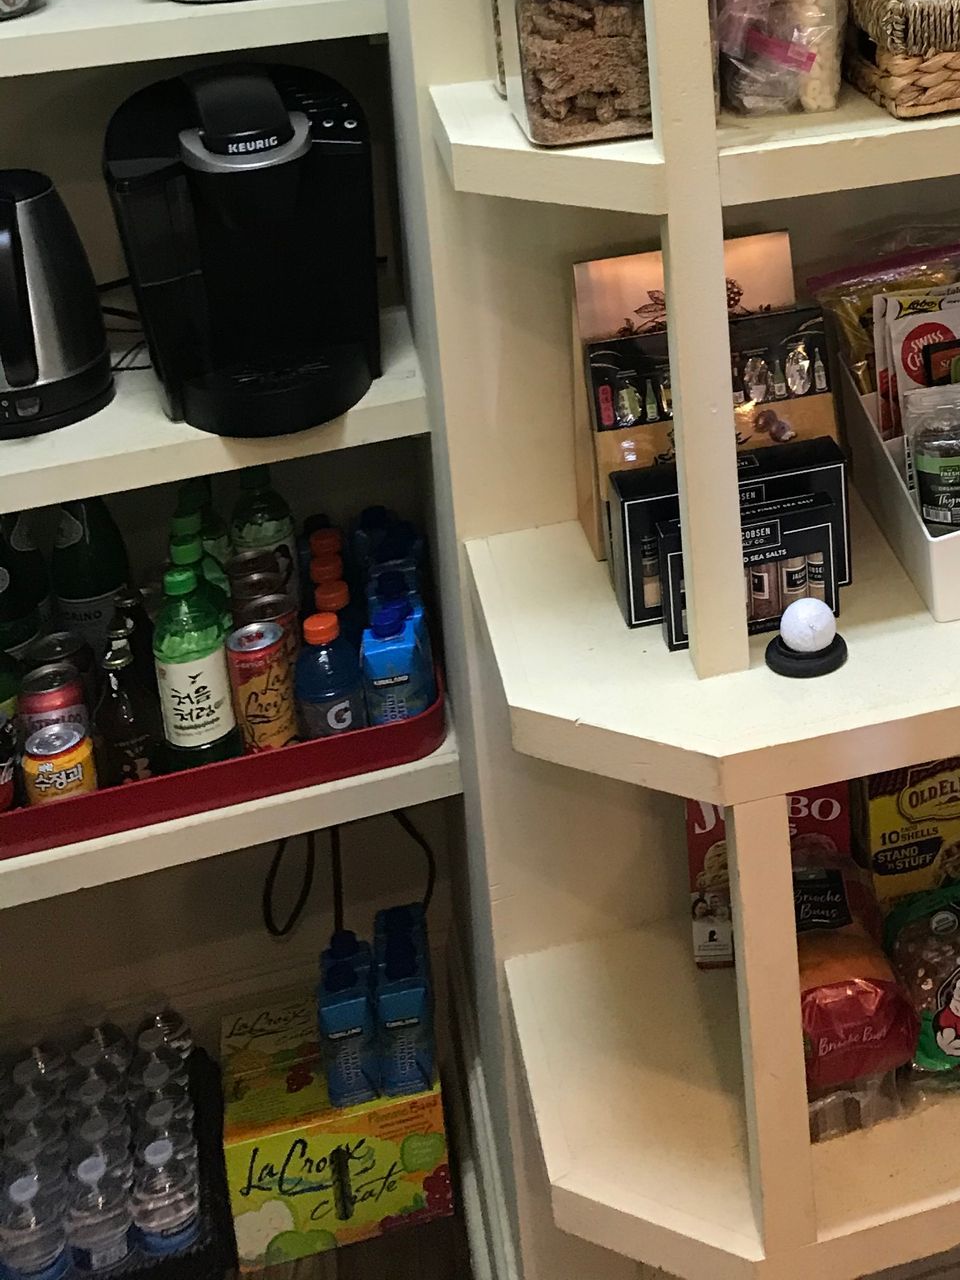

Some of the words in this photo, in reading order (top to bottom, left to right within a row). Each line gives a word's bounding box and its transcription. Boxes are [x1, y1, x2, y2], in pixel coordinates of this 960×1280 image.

[228, 136, 278, 154] KEURIG
[911, 329, 944, 352] SWISS
[741, 527, 771, 540] COBSEN
[750, 552, 765, 563] SEA
[766, 548, 788, 560] SALTS
[170, 684, 212, 706] 처음
[326, 699, 353, 730] G
[34, 765, 83, 791] 수정과
[908, 788, 938, 809] OLD
[939, 779, 956, 797] EL
[879, 830, 900, 846] 10
[900, 826, 939, 842] SHELLS
[877, 846, 919, 864] STAND
[896, 852, 934, 870] STUFF
